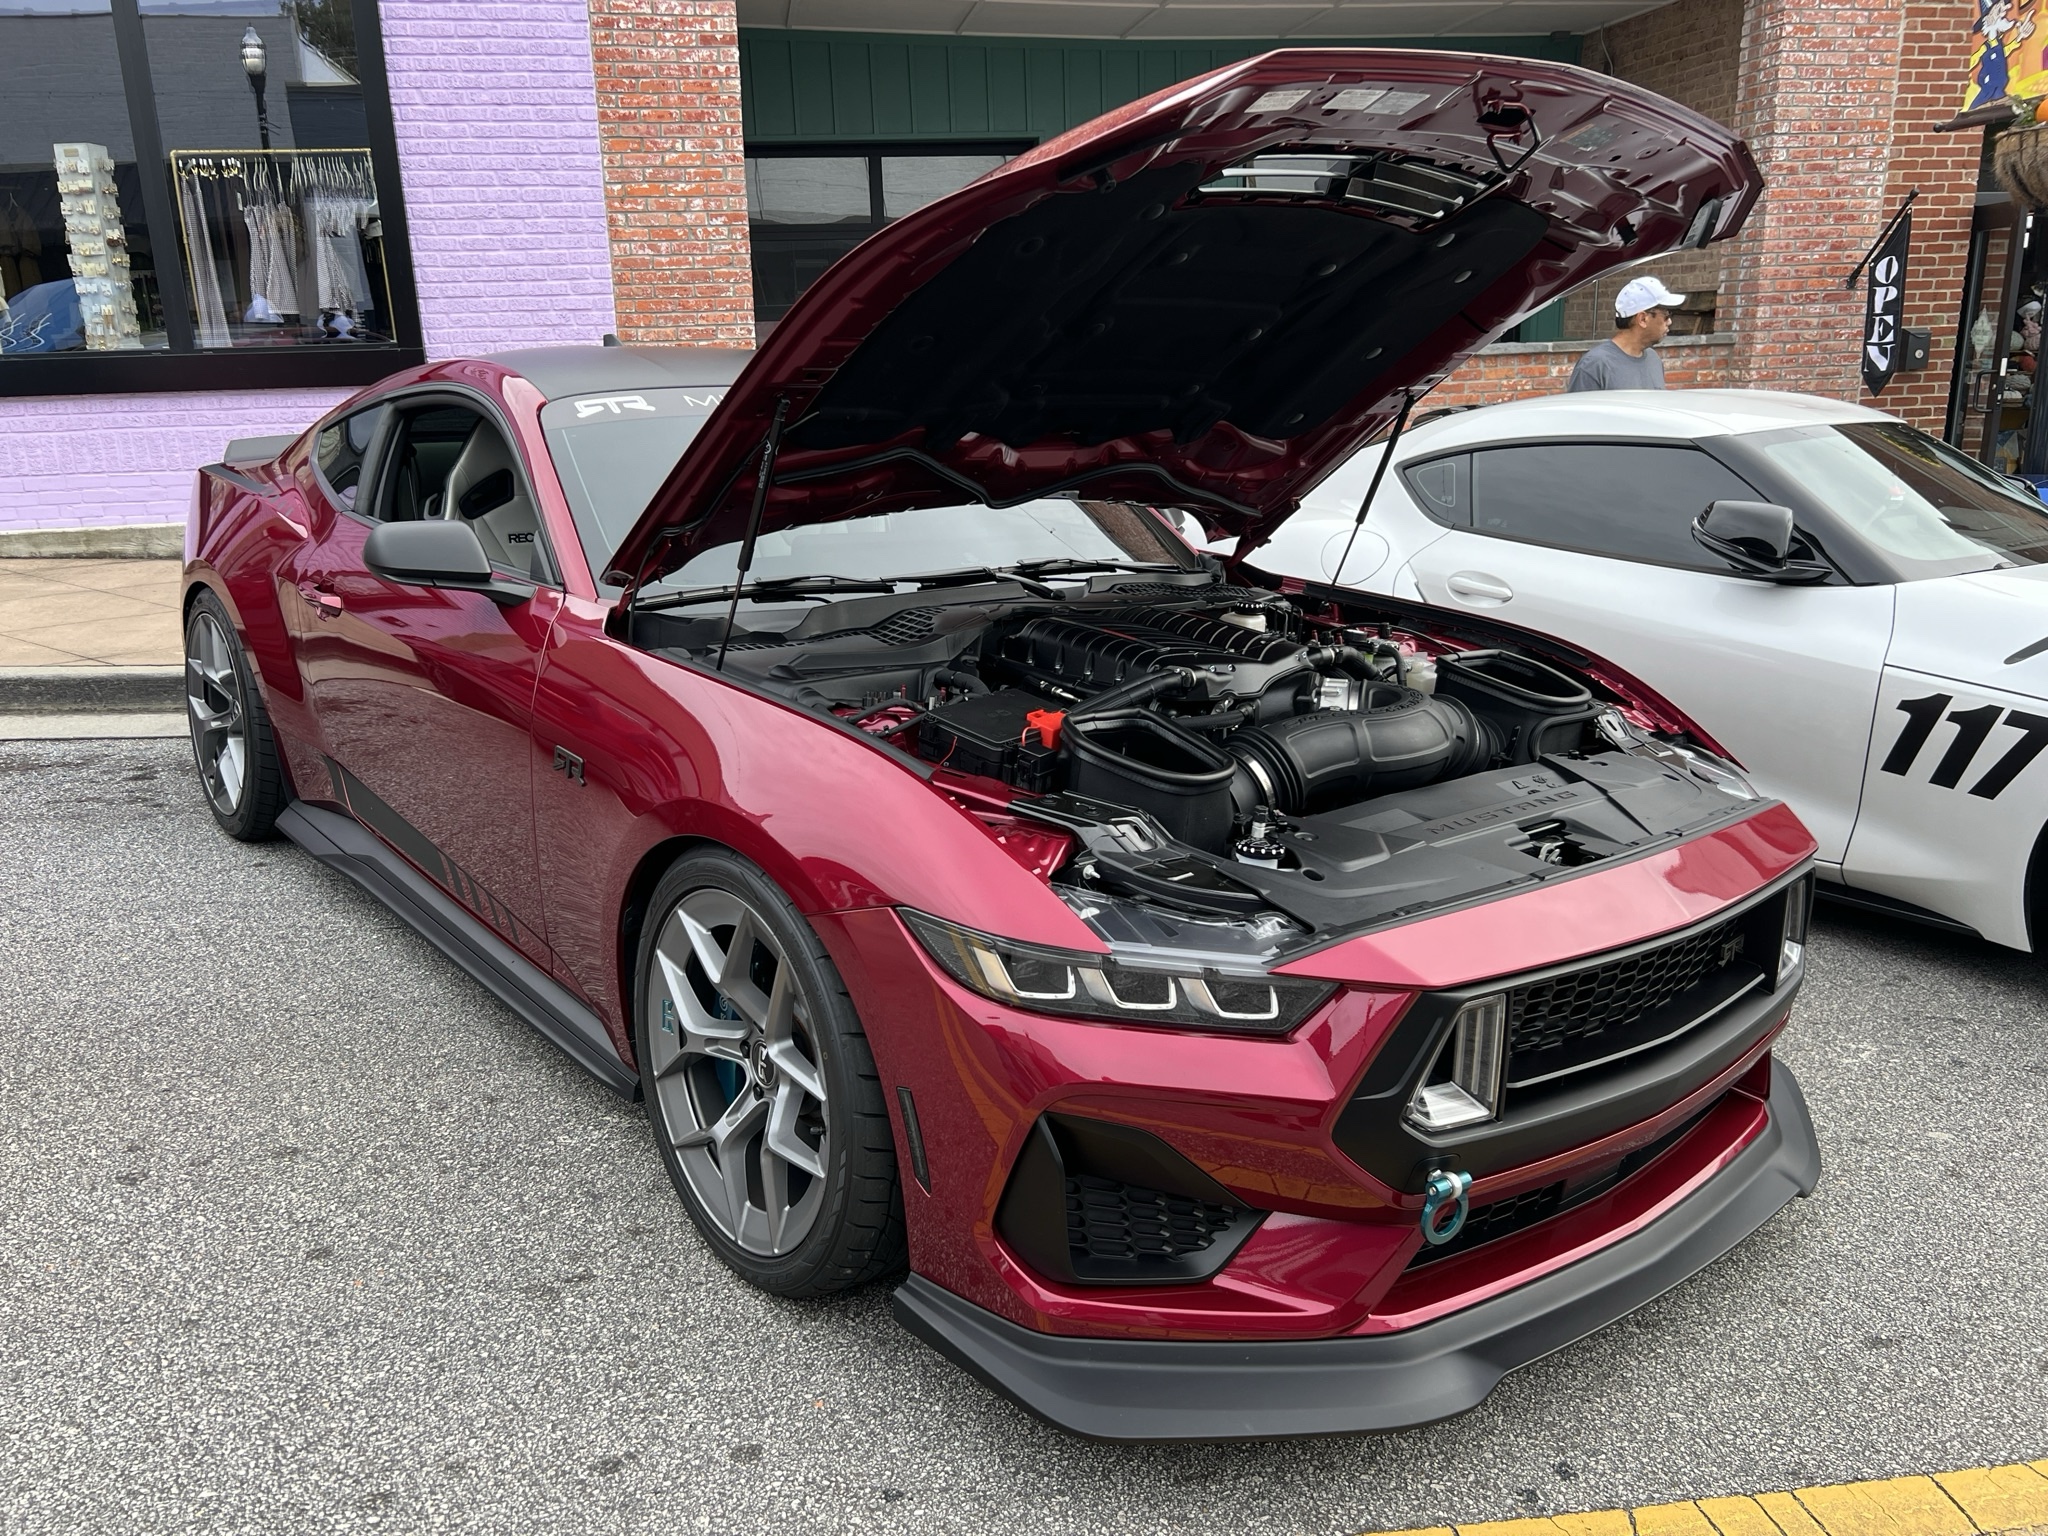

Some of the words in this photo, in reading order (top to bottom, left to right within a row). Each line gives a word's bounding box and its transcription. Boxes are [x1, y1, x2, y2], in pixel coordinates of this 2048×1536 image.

[1864, 255, 1899, 372] OPEN
[683, 394, 724, 407] M
[1880, 692, 2048, 801] 117
[1424, 790, 1579, 835] MUSTANG
